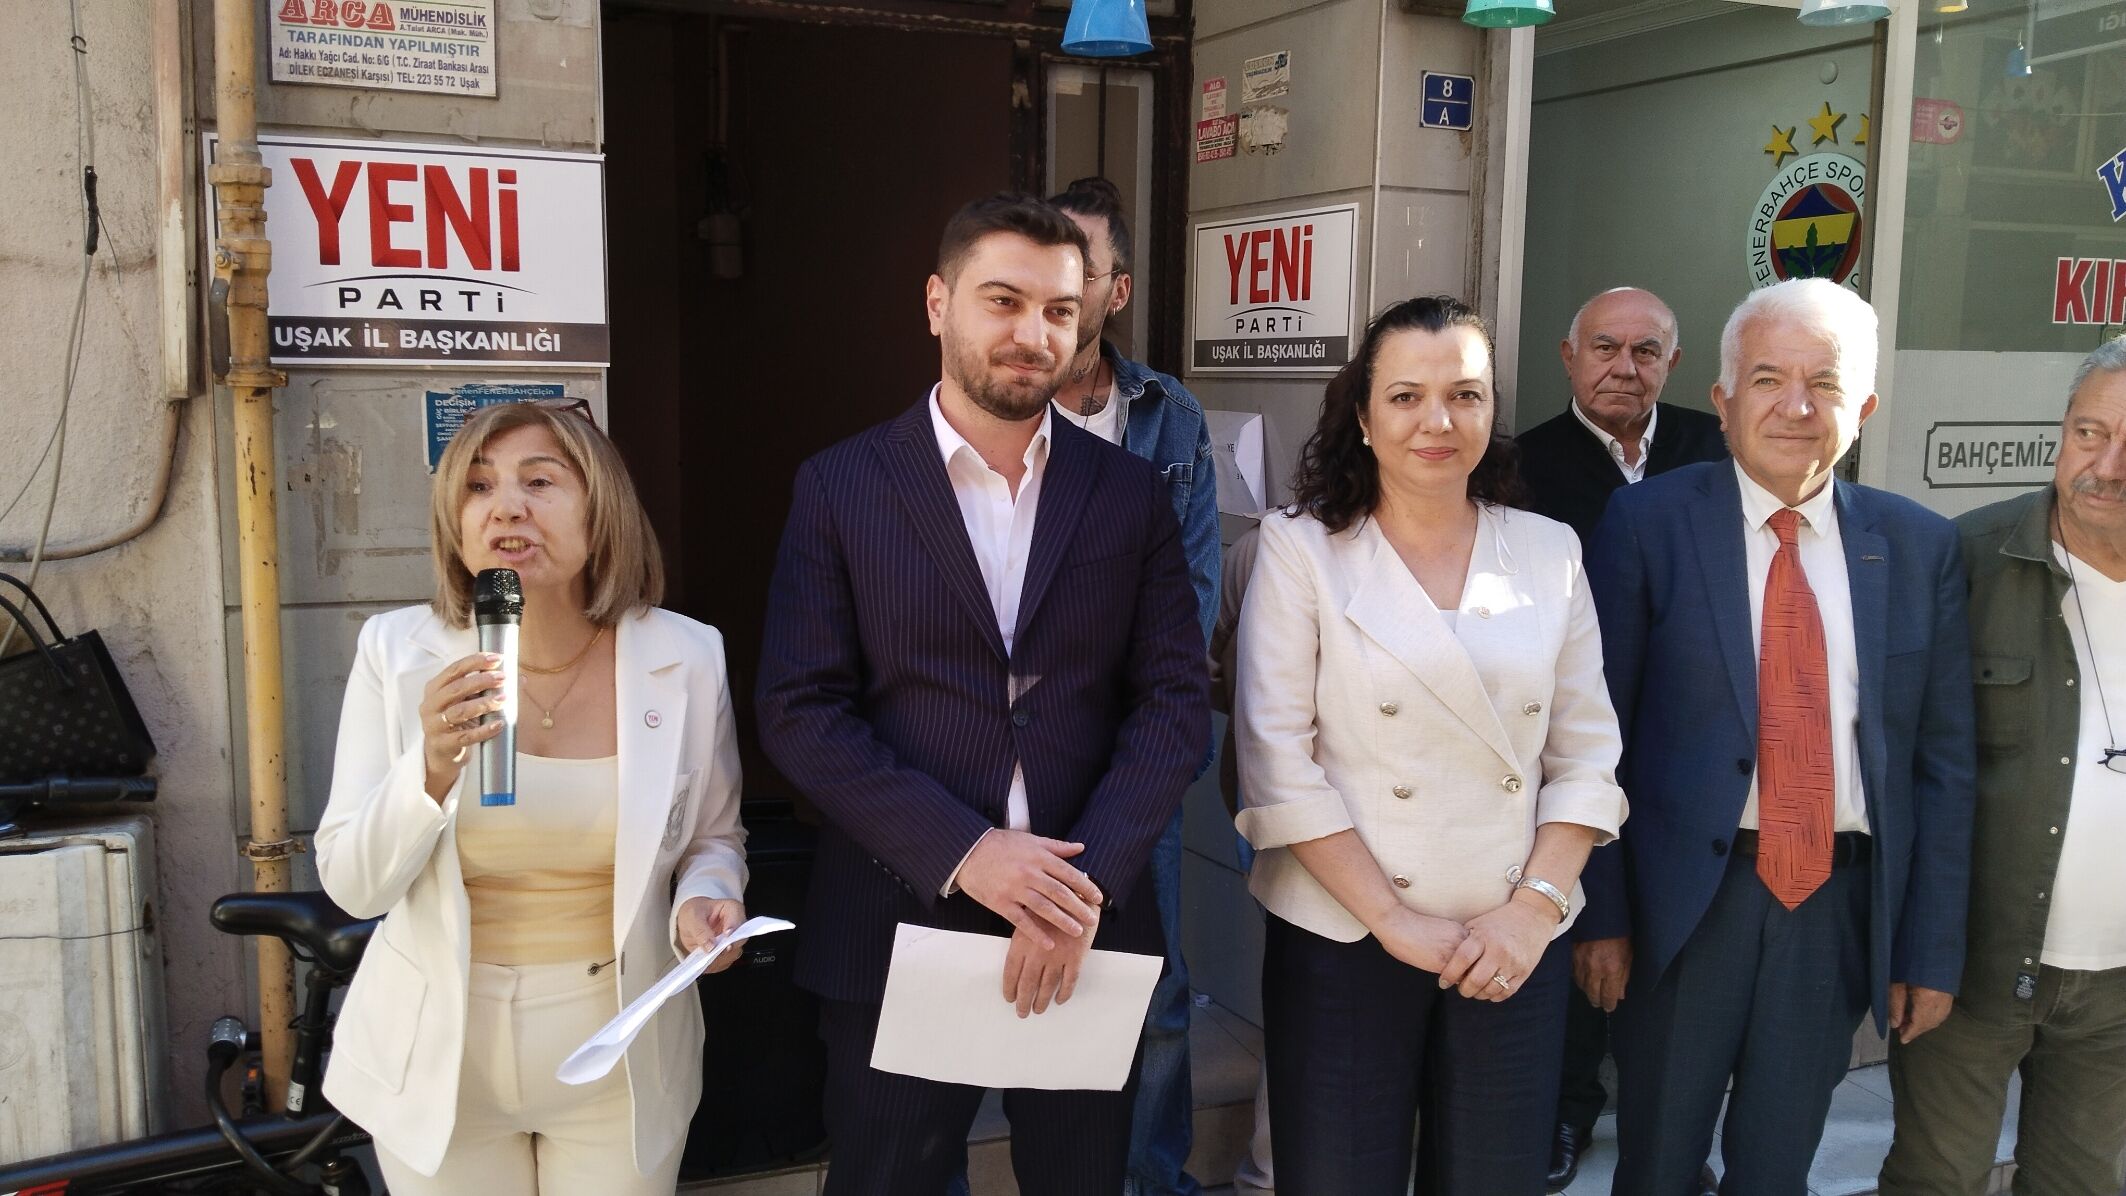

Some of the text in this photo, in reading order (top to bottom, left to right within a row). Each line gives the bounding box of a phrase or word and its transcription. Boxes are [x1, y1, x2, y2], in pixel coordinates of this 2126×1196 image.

[277, 0, 396, 31] ARCA
[400, 7, 487, 28] MÜHENDİSLİK
[288, 29, 480, 58] TARAFINDAN YAPILMIŞTIR
[279, 47, 292, 59] Ad:
[294, 48, 317, 61] Hakkı
[318, 49, 341, 64] Yağcı
[342, 52, 360, 64] Cad.
[362, 54, 375, 65] No:
[413, 57, 436, 70] Ziraat
[437, 58, 469, 73] Bankası
[469, 61, 489, 75] Arası
[289, 62, 315, 77] DİLEK
[317, 64, 360, 80] ECZANESİ
[397, 72, 415, 84] TEL:
[416, 73, 432, 86] 223
[433, 74, 444, 87] 55
[445, 75, 456, 88] 72
[459, 77, 480, 91] Uşak
[1443, 79, 1453, 98] 8
[1439, 106, 1450, 126] A
[1753, 161, 1820, 287] ENERBAHÇE
[275, 322, 561, 355] UŞAK İL BAŞKANLIĞI
[1212, 339, 1326, 363] UŞAK İL BAŞKANLIĞI
[1937, 433, 2057, 475] BAHÇEMİZ
[752, 955, 776, 965] AUDIO
